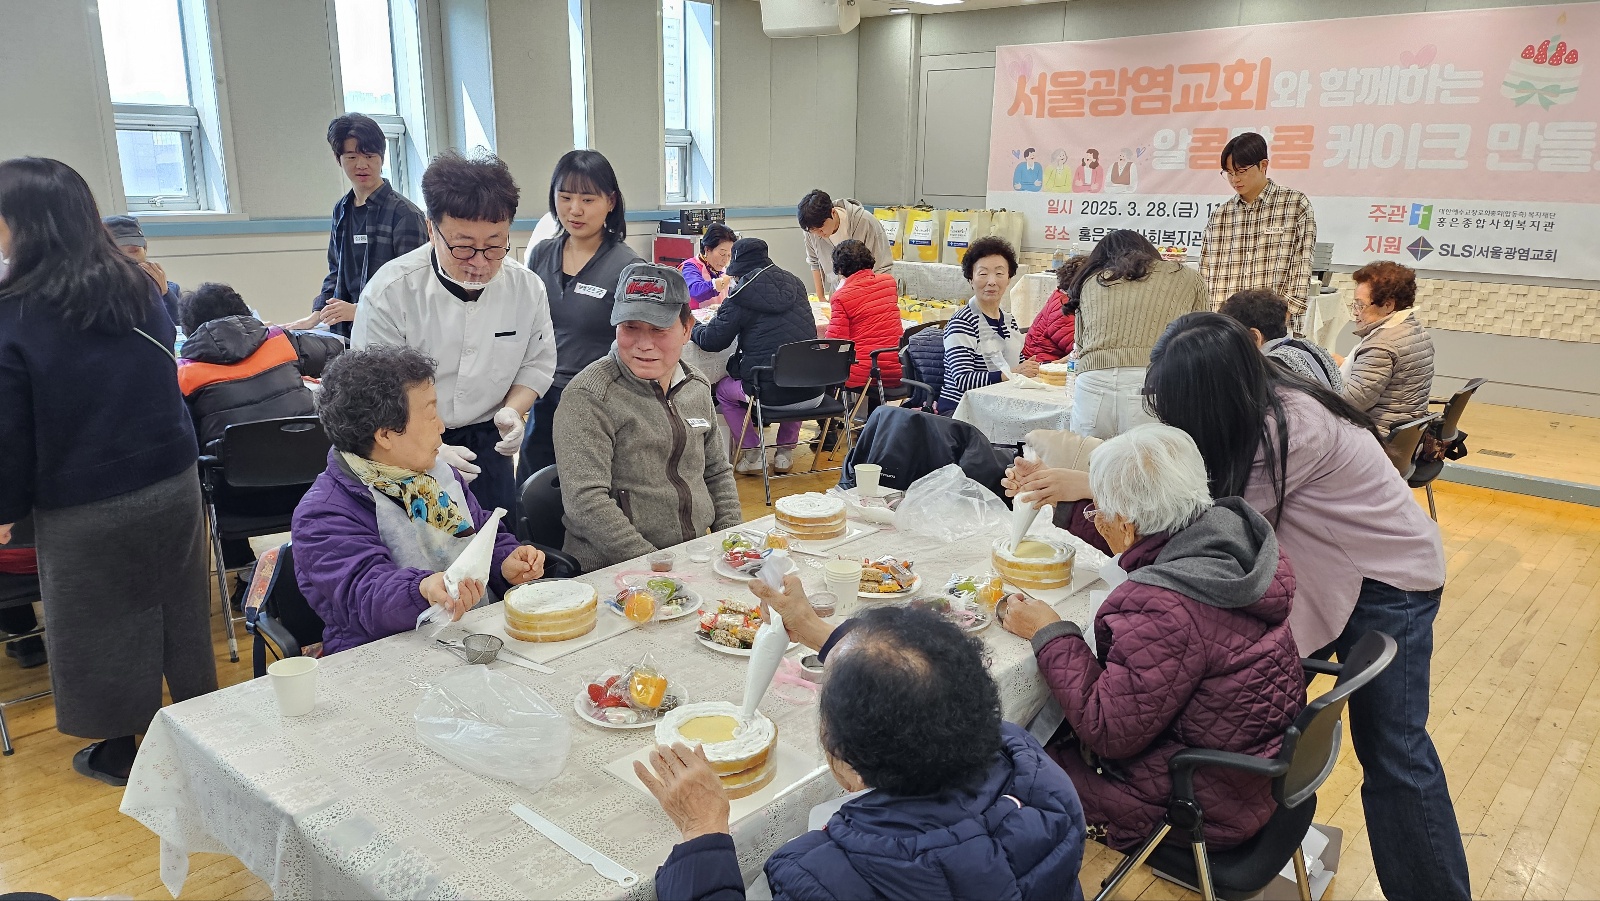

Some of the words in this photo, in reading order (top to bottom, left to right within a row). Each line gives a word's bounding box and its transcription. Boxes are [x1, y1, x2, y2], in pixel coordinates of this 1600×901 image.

[1007, 57, 1313, 118] 서울광염교회와
[1319, 64, 1484, 107] 함께하는
[1152, 125, 1315, 170] 알콤콤
[1323, 122, 1472, 170] 케이크
[1486, 122, 1600, 173] 만들
[1047, 199, 1073, 215] 일시
[1080, 201, 1122, 216] 2025.
[1127, 202, 1141, 217] 3.
[1145, 202, 1199, 218] 28.(금)
[1368, 204, 1408, 224] 주관
[1528, 211, 1556, 219] 복지재단
[1044, 225, 1071, 241] 장소
[1437, 217, 1556, 232] 홍은종합사회복지관
[1362, 235, 1402, 254] 지원
